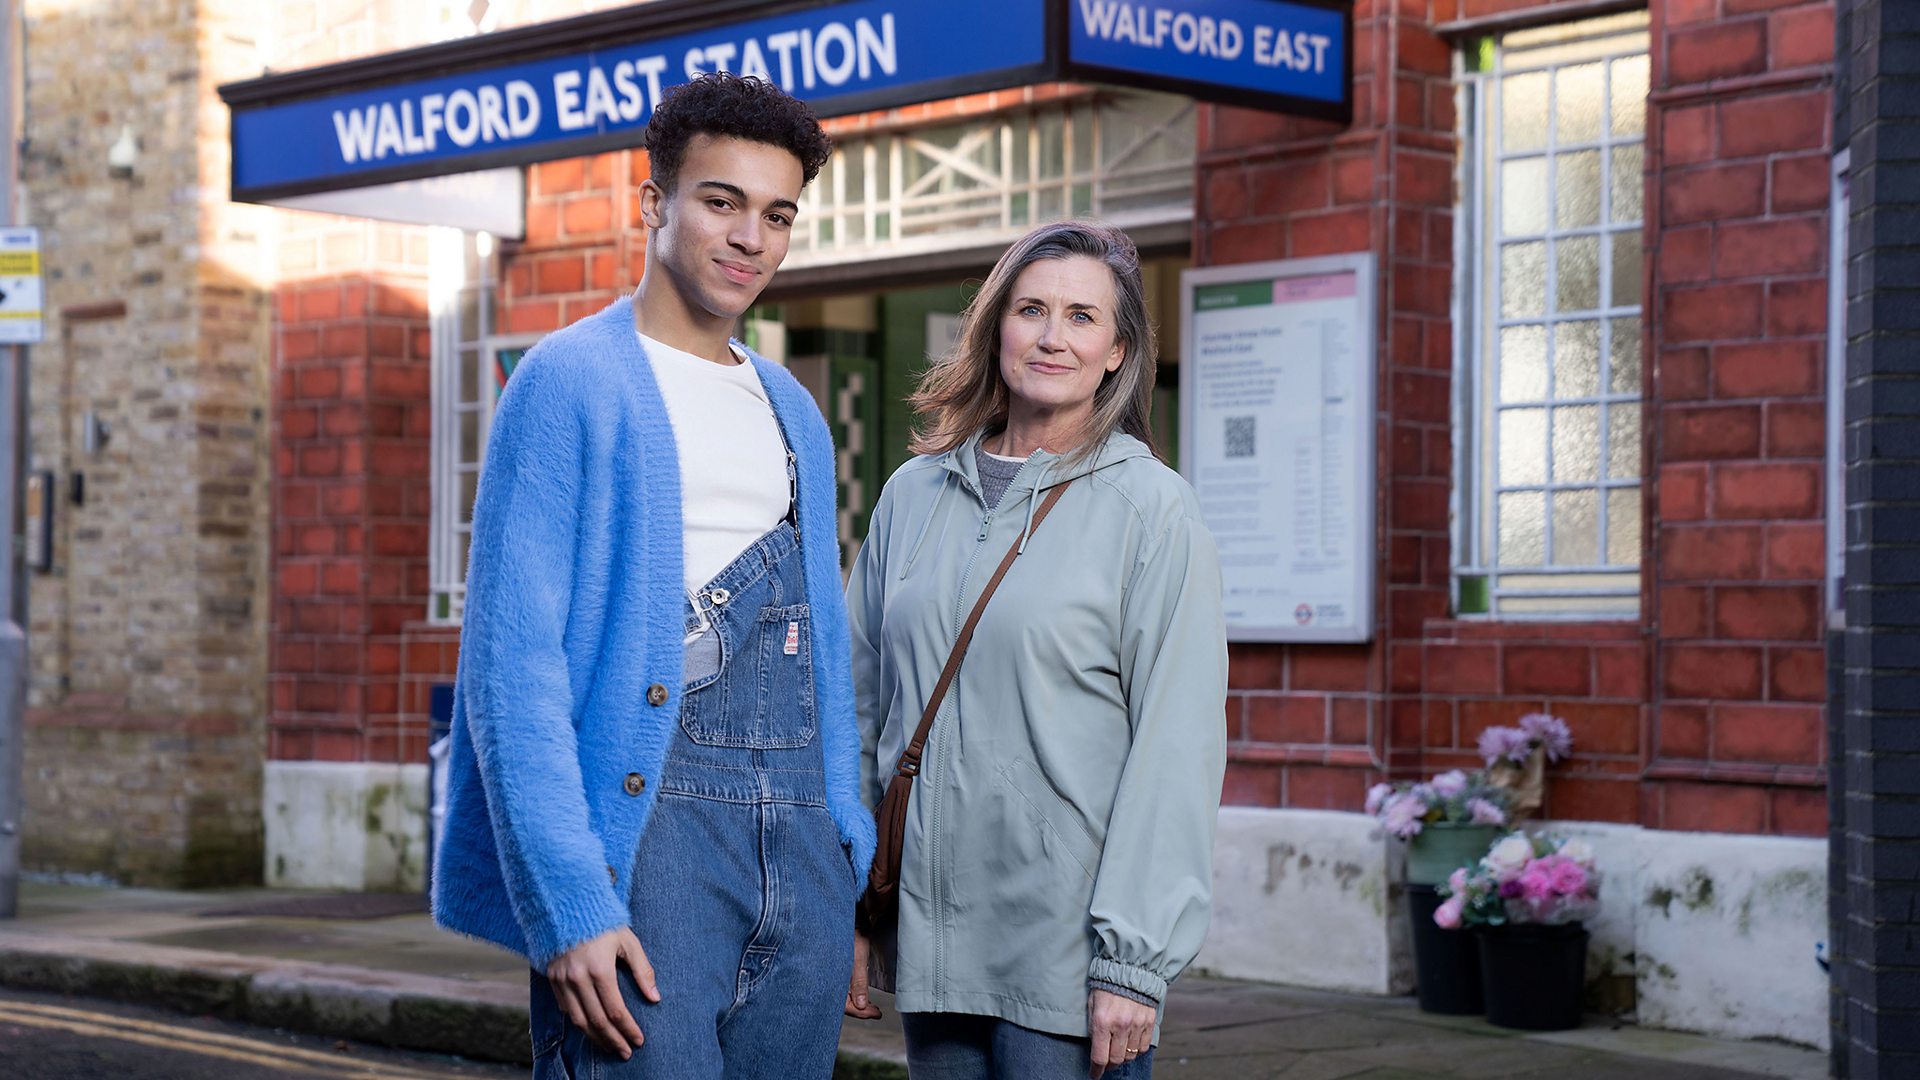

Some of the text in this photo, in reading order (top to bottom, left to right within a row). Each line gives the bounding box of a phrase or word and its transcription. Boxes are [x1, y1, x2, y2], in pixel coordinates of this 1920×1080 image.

[333, 12, 897, 163] WALFORD EAST STATION
[1079, 0, 1330, 74] WALFORD EAST
